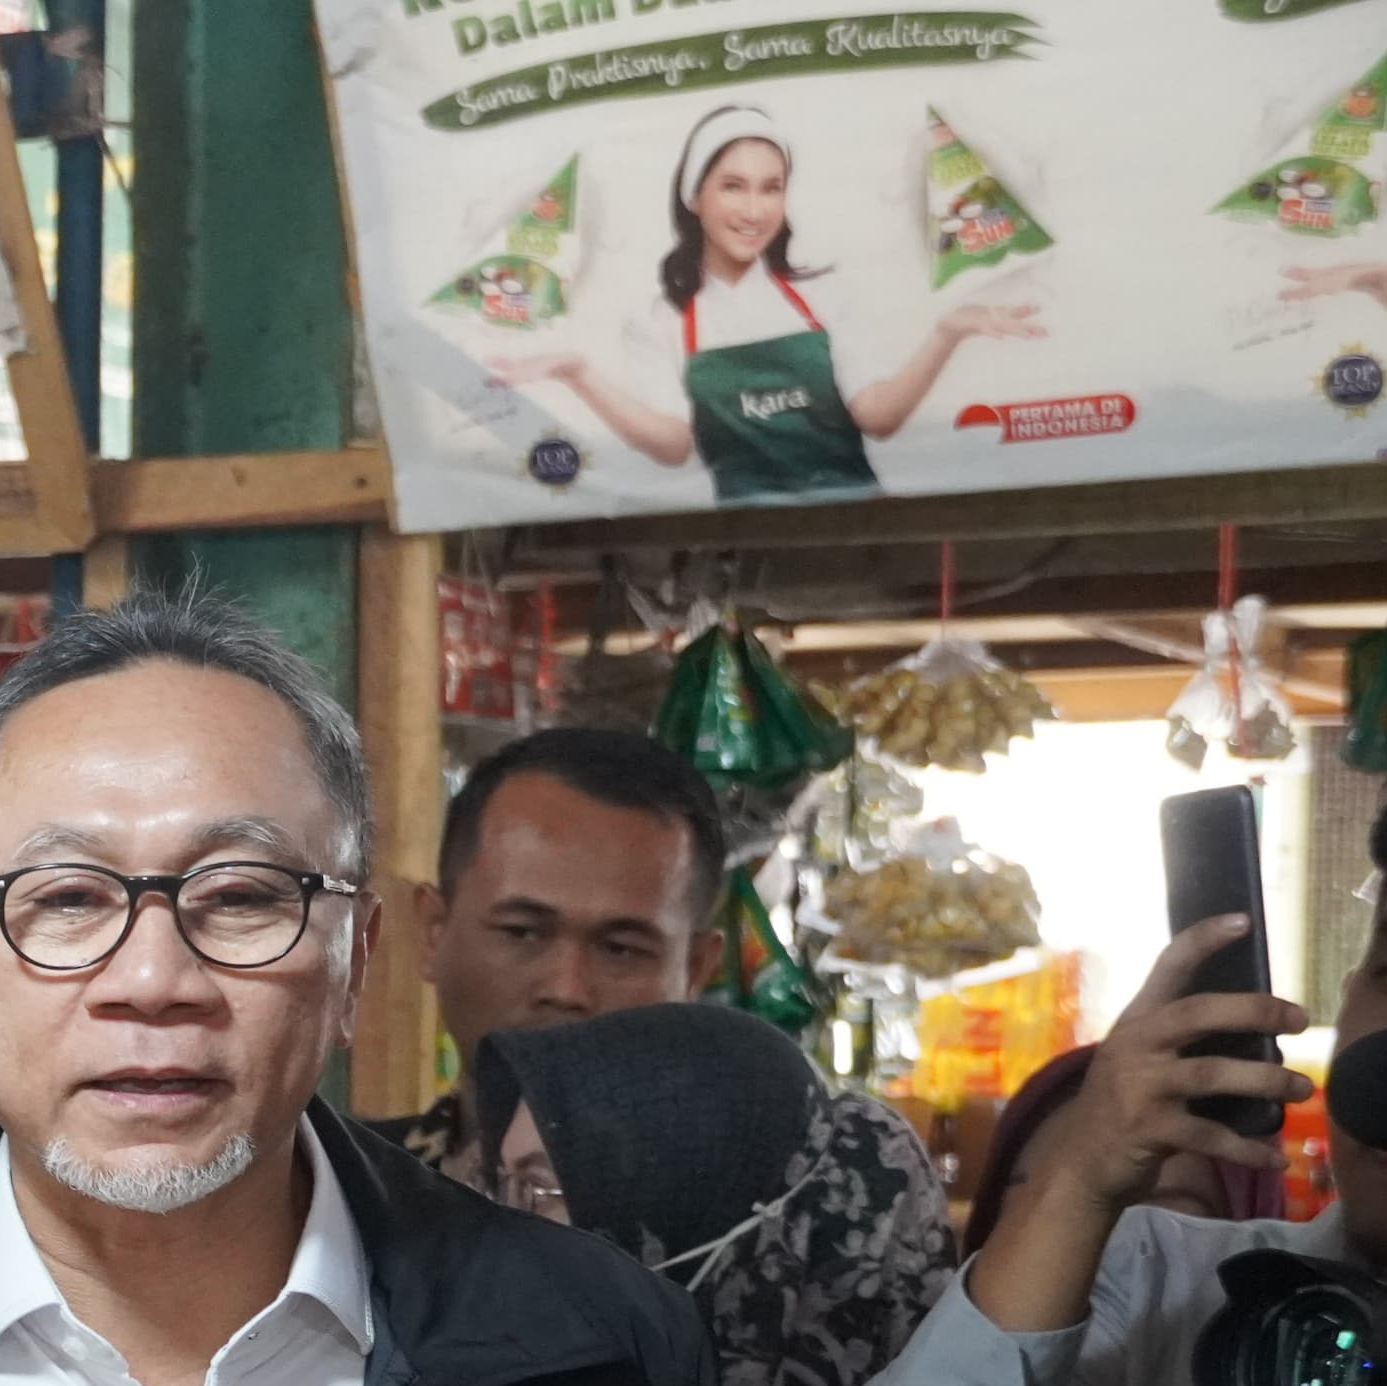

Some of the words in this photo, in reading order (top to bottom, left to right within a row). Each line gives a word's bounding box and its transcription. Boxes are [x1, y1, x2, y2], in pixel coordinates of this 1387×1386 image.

[451, 0, 617, 57] Dalam
[455, 81, 534, 126] Sama
[547, 46, 707, 100] Praktisnya,
[723, 30, 813, 71] Sama
[826, 14, 1014, 60] Kualitasnya
[1008, 400, 1096, 422] PERTAMA
[1100, 397, 1122, 415] DI
[1010, 416, 1125, 440] INDONESIA
